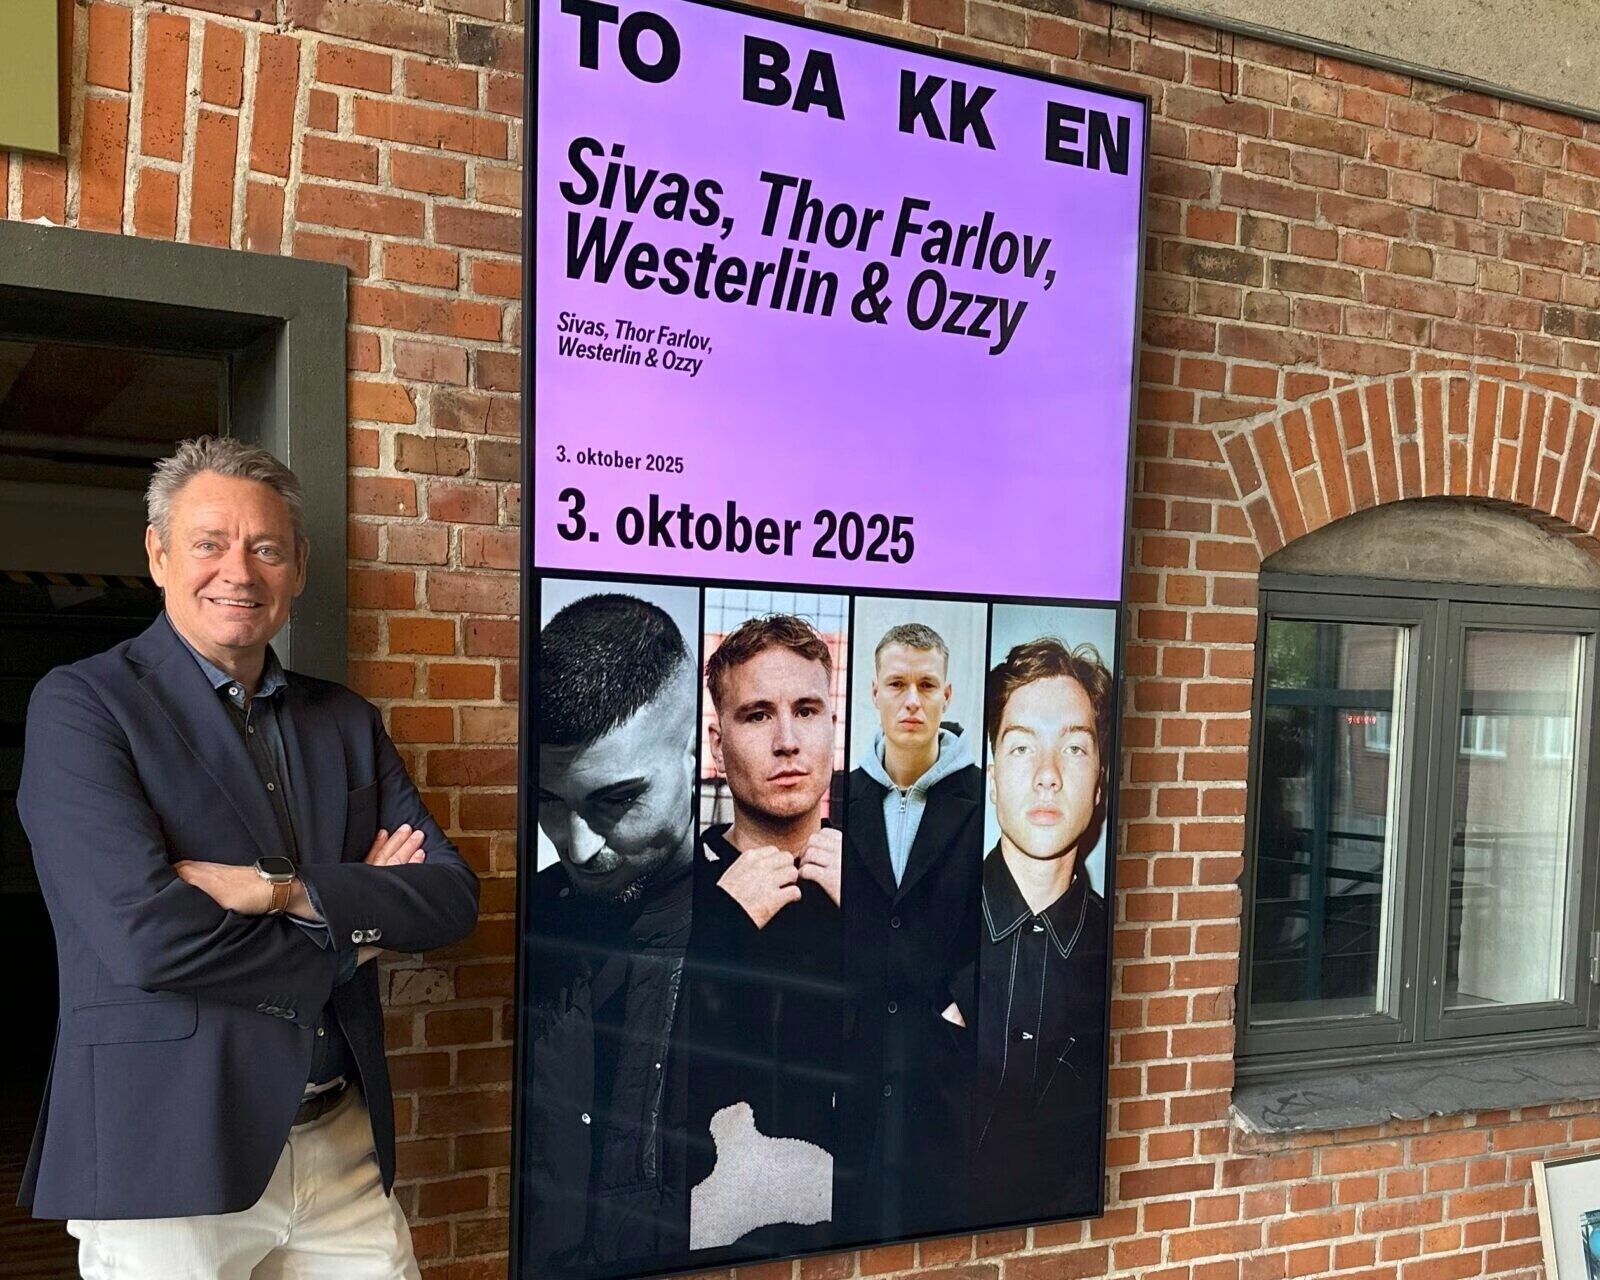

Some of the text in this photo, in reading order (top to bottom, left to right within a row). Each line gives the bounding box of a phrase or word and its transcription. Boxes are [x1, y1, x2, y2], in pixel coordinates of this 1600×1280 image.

[561, 0, 1131, 176] TO BA KK EN
[559, 136, 1058, 291] Sivas, Thor Farlov,
[566, 210, 1029, 356] Westerlin & Ozzy
[557, 311, 713, 355] Sivas, Thor Farlov,
[558, 335, 704, 378] Westerlin & Ozzy
[556, 445, 684, 474] 3. oktober 2025
[556, 487, 915, 564] 3. oktober 2025
